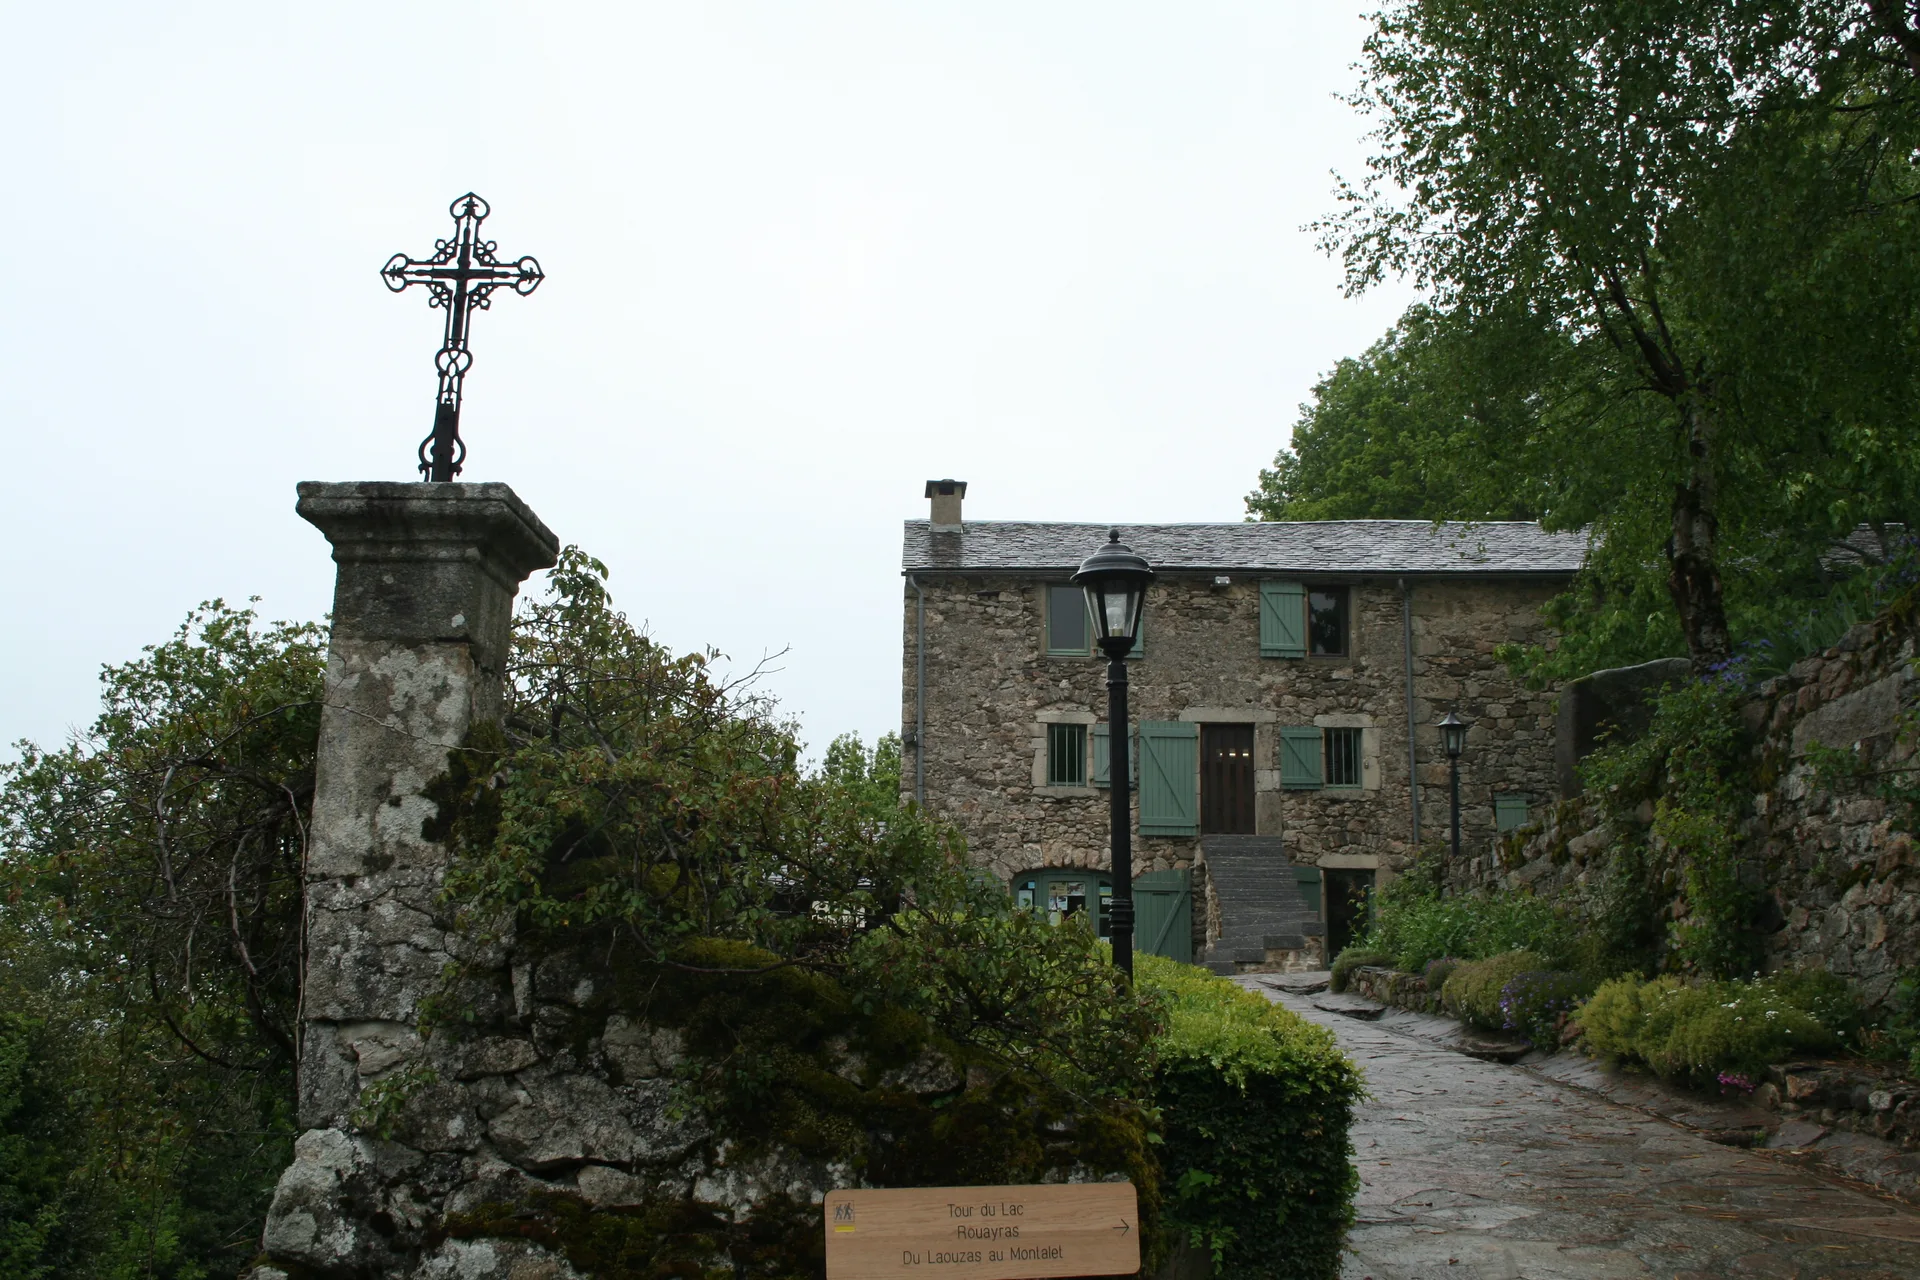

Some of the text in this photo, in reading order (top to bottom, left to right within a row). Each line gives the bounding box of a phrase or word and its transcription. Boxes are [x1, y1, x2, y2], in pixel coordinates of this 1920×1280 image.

[947, 1202, 1024, 1218] Tour du Lac
[957, 1224, 1019, 1241] Rouayras
[903, 1245, 1064, 1265] Du Laouzas au Montalet
